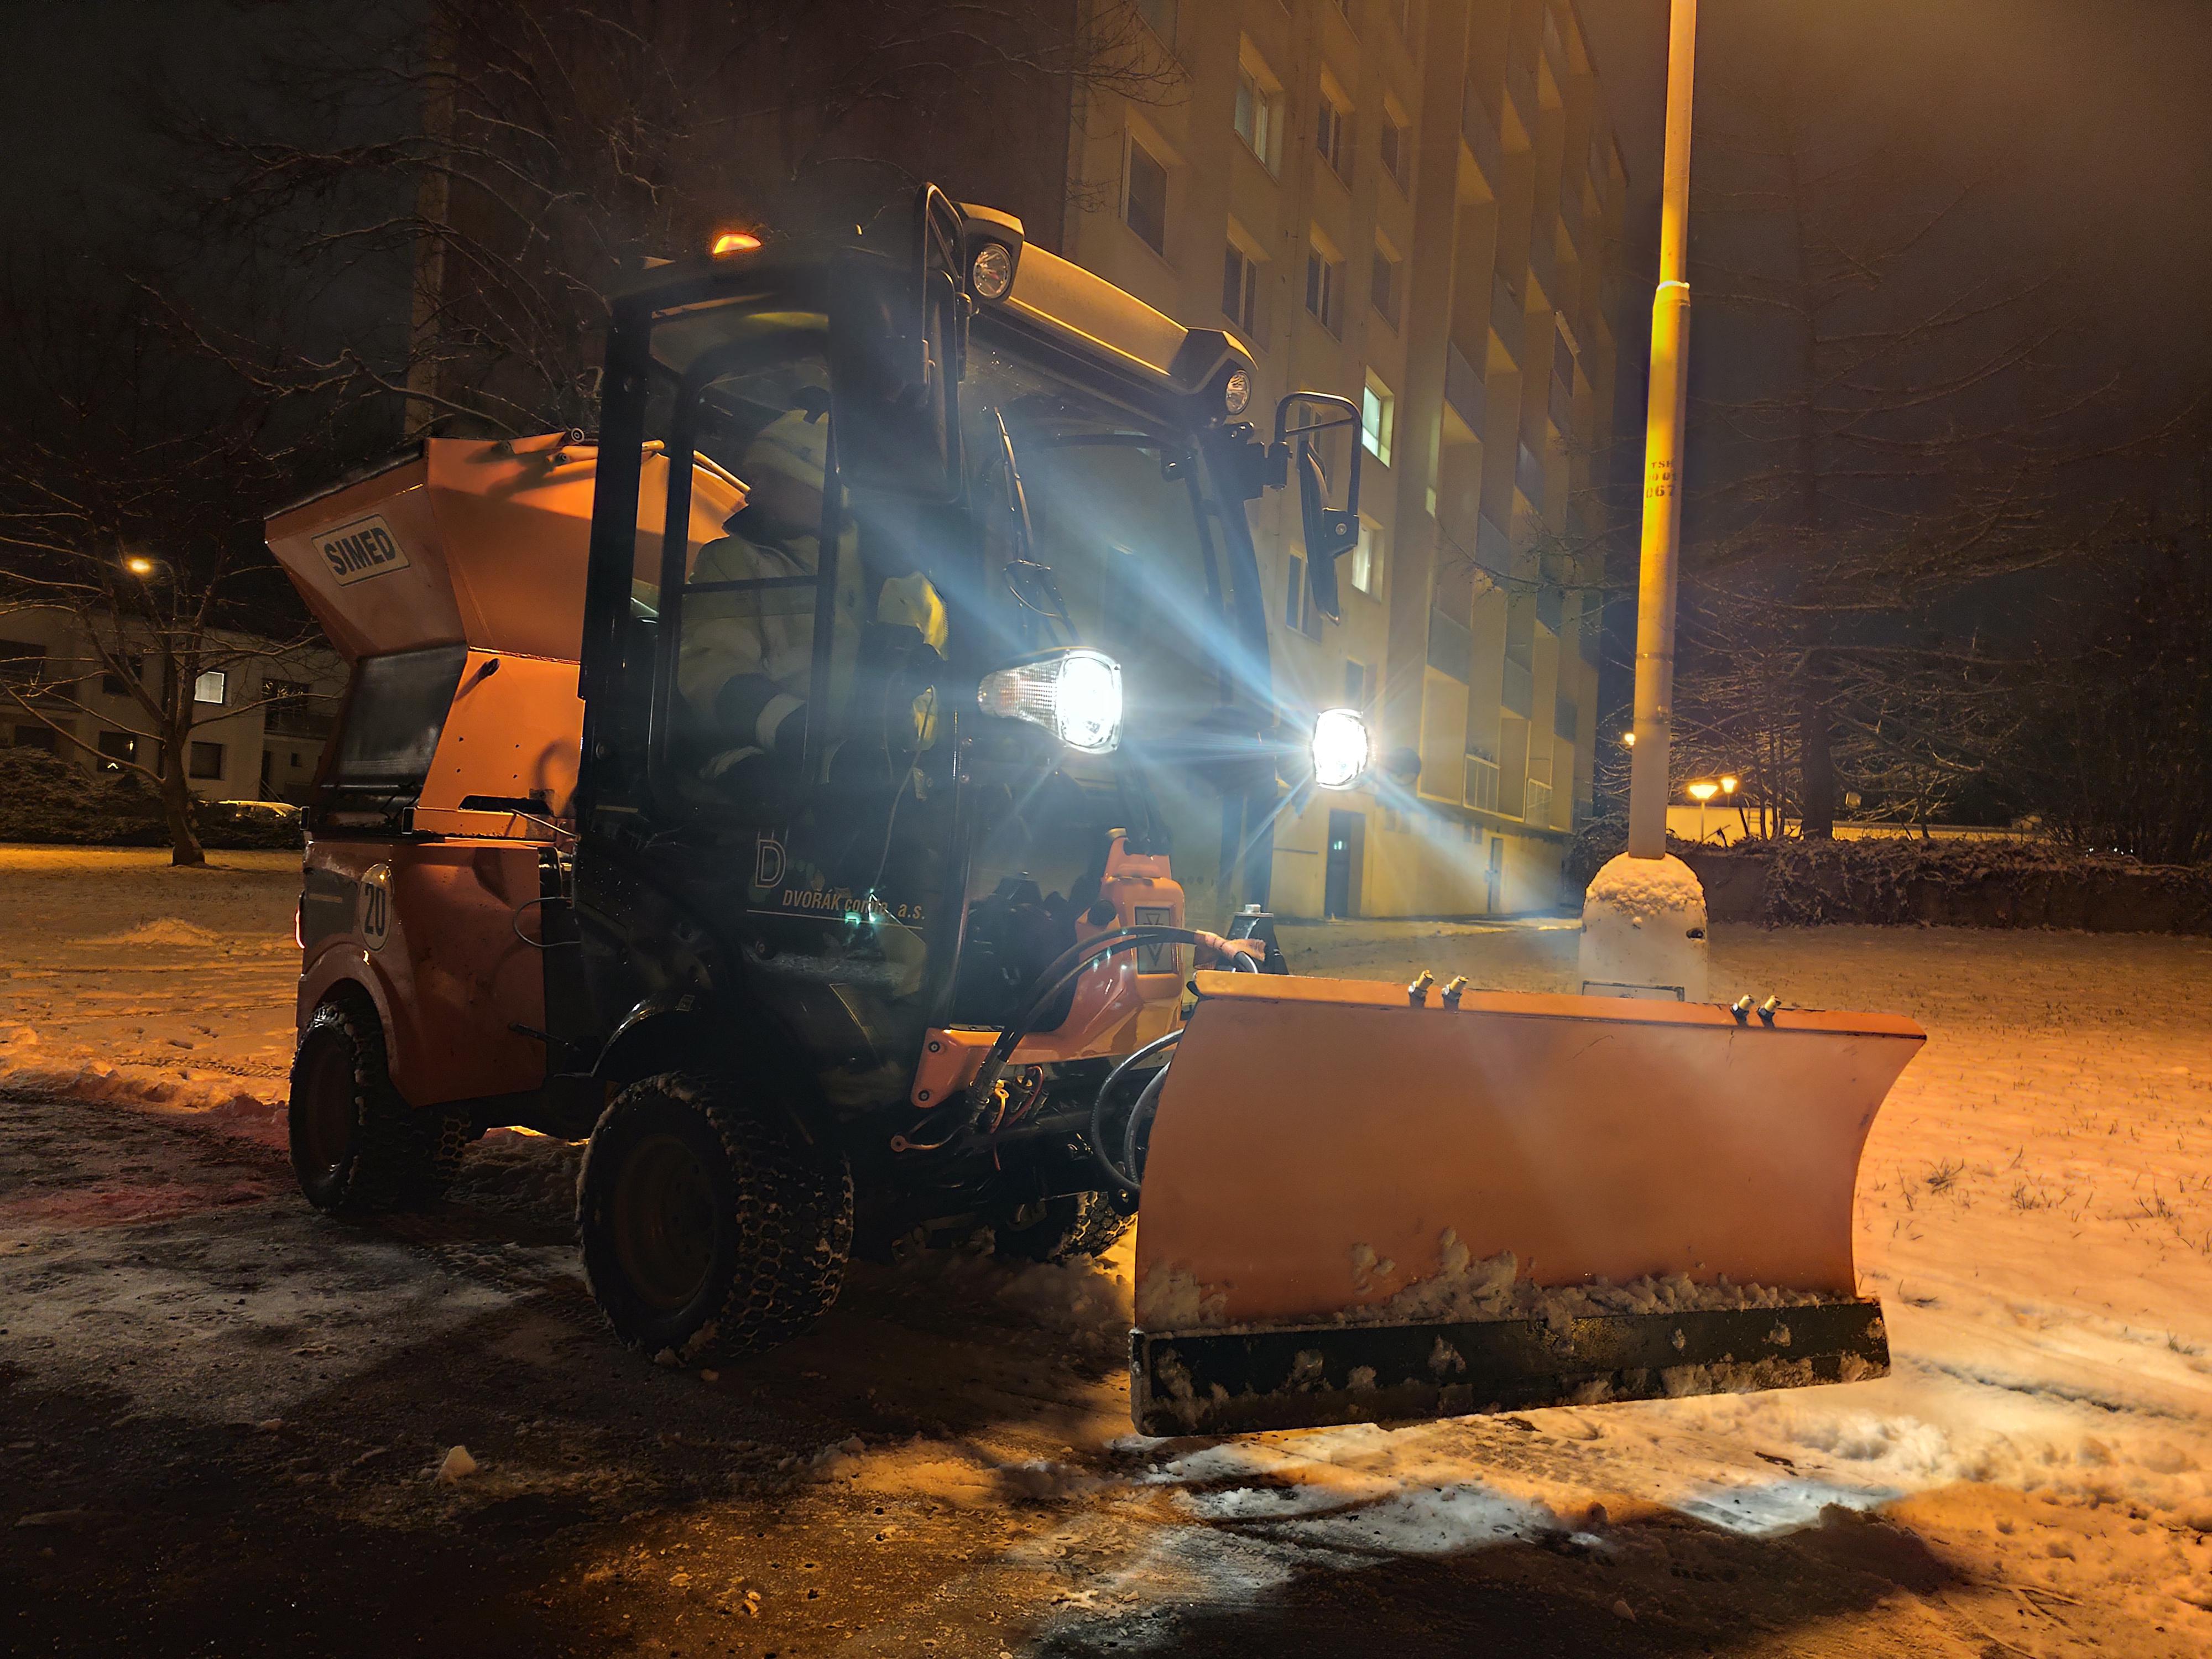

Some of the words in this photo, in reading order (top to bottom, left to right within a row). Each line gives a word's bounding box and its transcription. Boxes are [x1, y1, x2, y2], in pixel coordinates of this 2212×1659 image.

[324, 528, 395, 575] SIMED
[364, 883, 385, 936] 20
[782, 888, 841, 911] DVOŘÁK
[898, 903, 926, 920] a.s.
